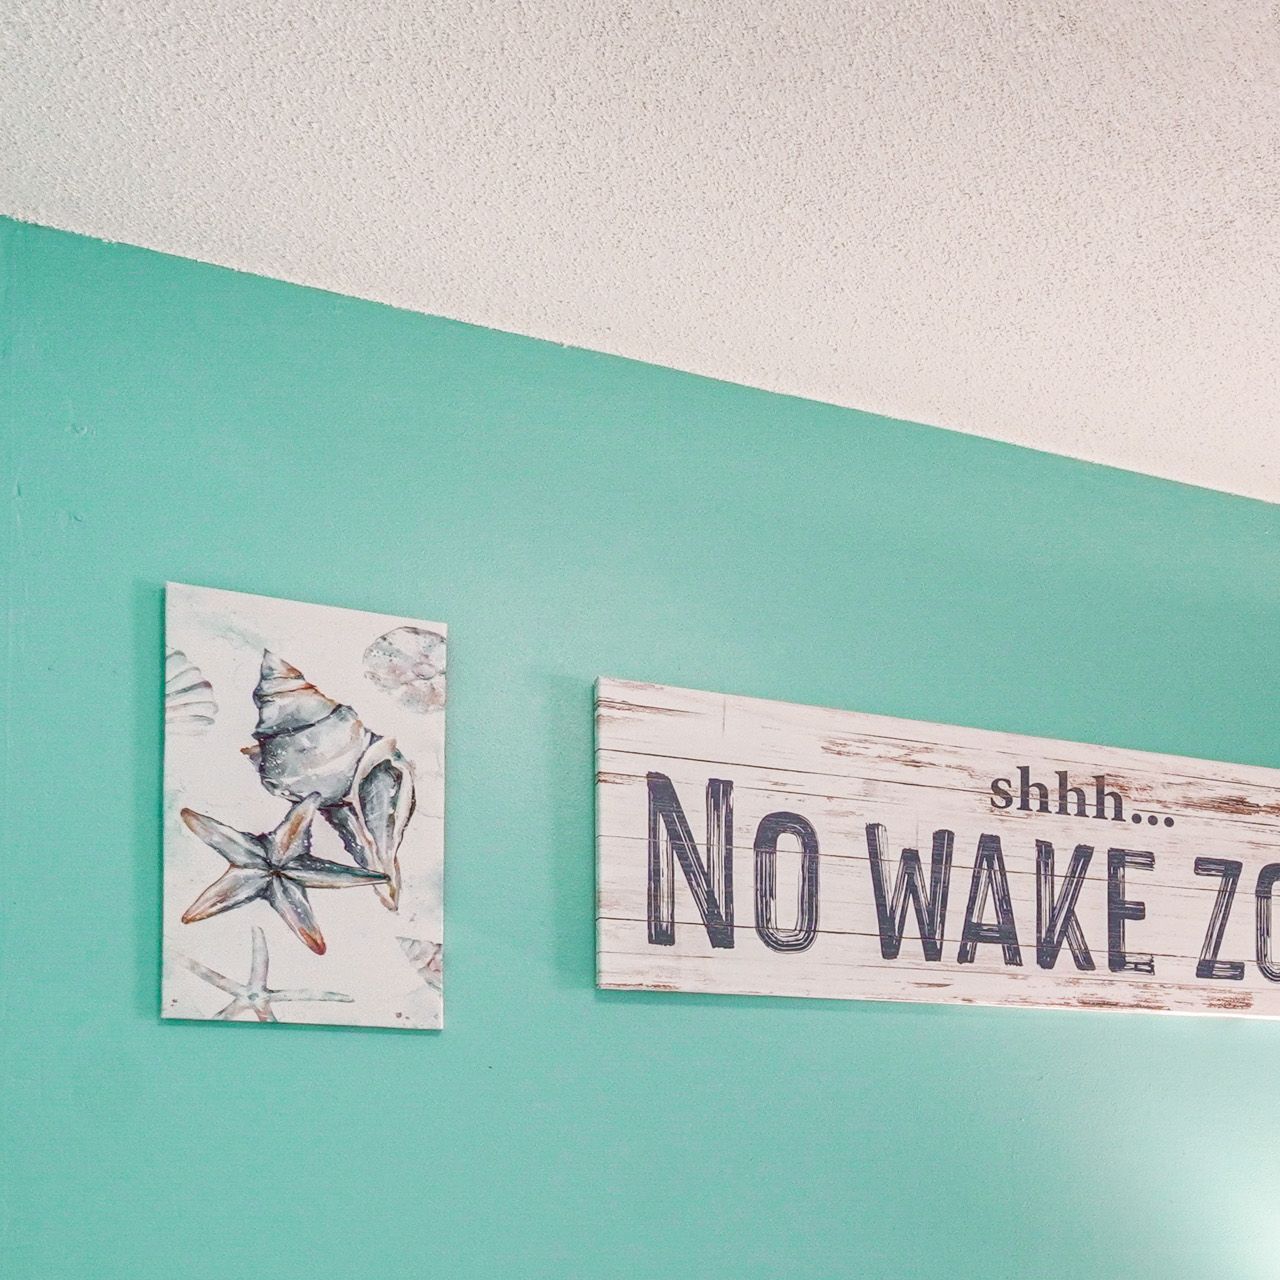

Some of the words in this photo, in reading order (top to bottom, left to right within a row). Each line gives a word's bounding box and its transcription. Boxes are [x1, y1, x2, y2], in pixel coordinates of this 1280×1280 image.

[990, 765, 1176, 829] shhh...
[646, 770, 821, 955] NO
[865, 822, 1156, 976] WAKE
